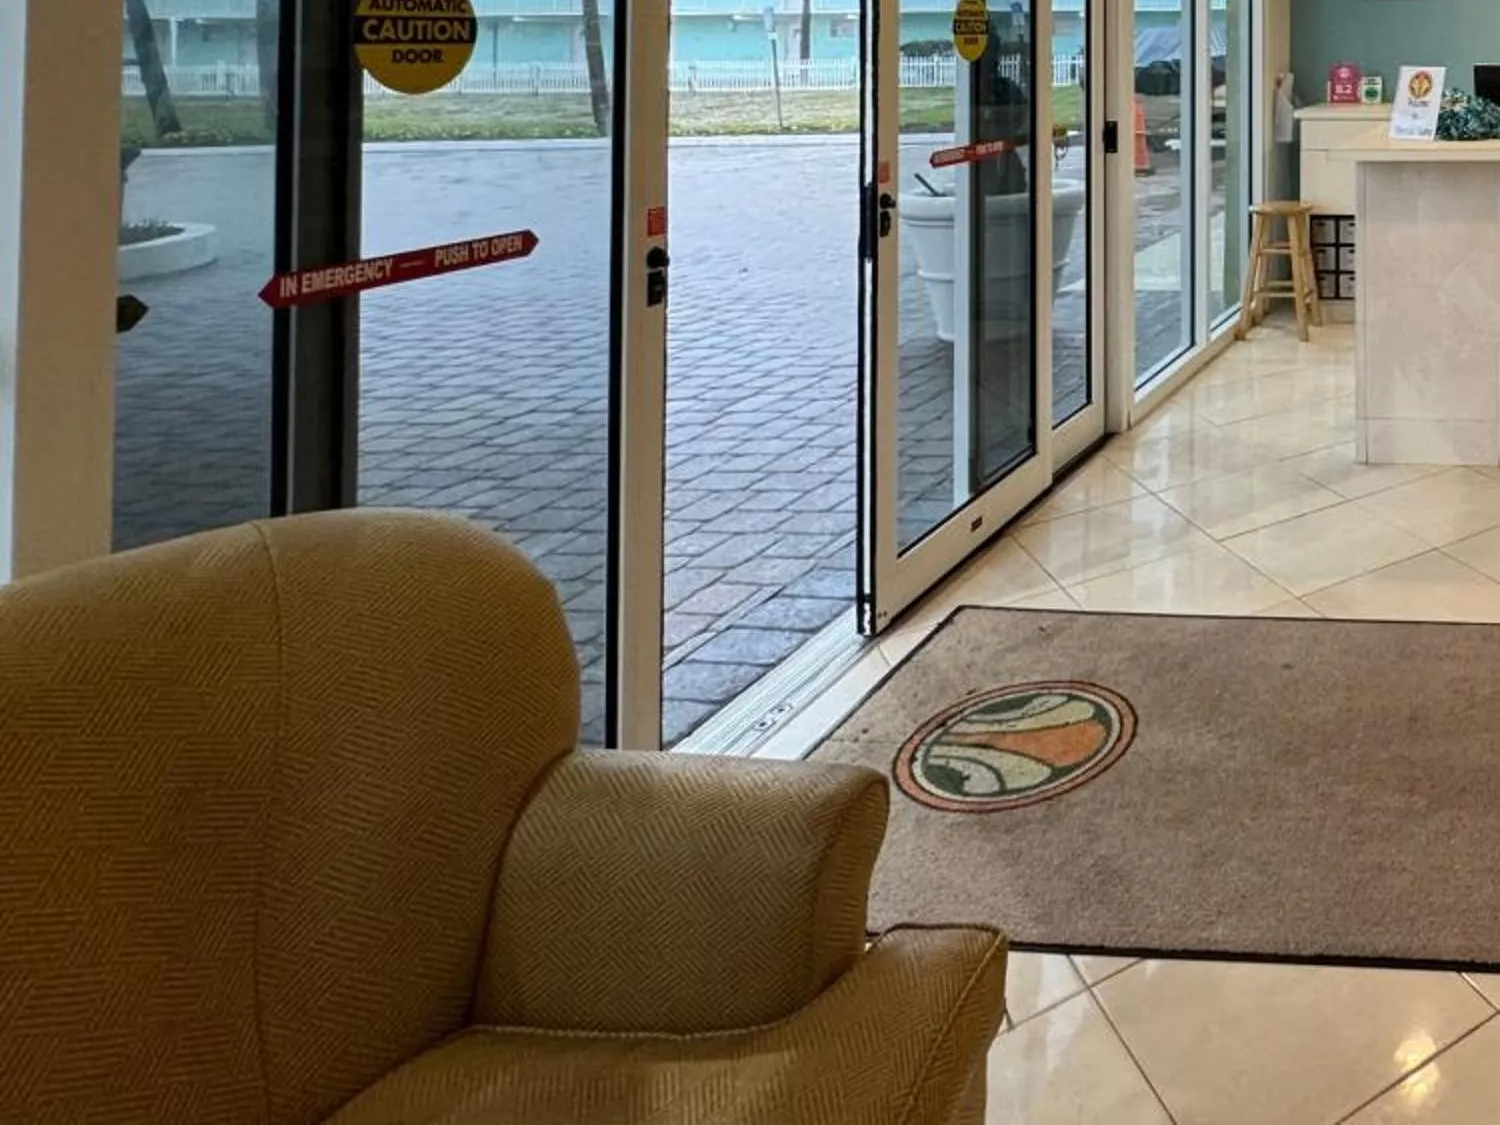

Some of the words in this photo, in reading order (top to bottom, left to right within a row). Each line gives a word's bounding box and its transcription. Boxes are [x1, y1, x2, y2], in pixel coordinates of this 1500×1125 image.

[362, 18, 471, 41] CAUTION
[391, 48, 446, 64] DOOR
[279, 275, 298, 298] IN
[301, 258, 394, 295] EMERGENCY
[434, 247, 470, 268] PUSH
[471, 241, 489, 260] TO
[491, 234, 524, 255] OPEN
